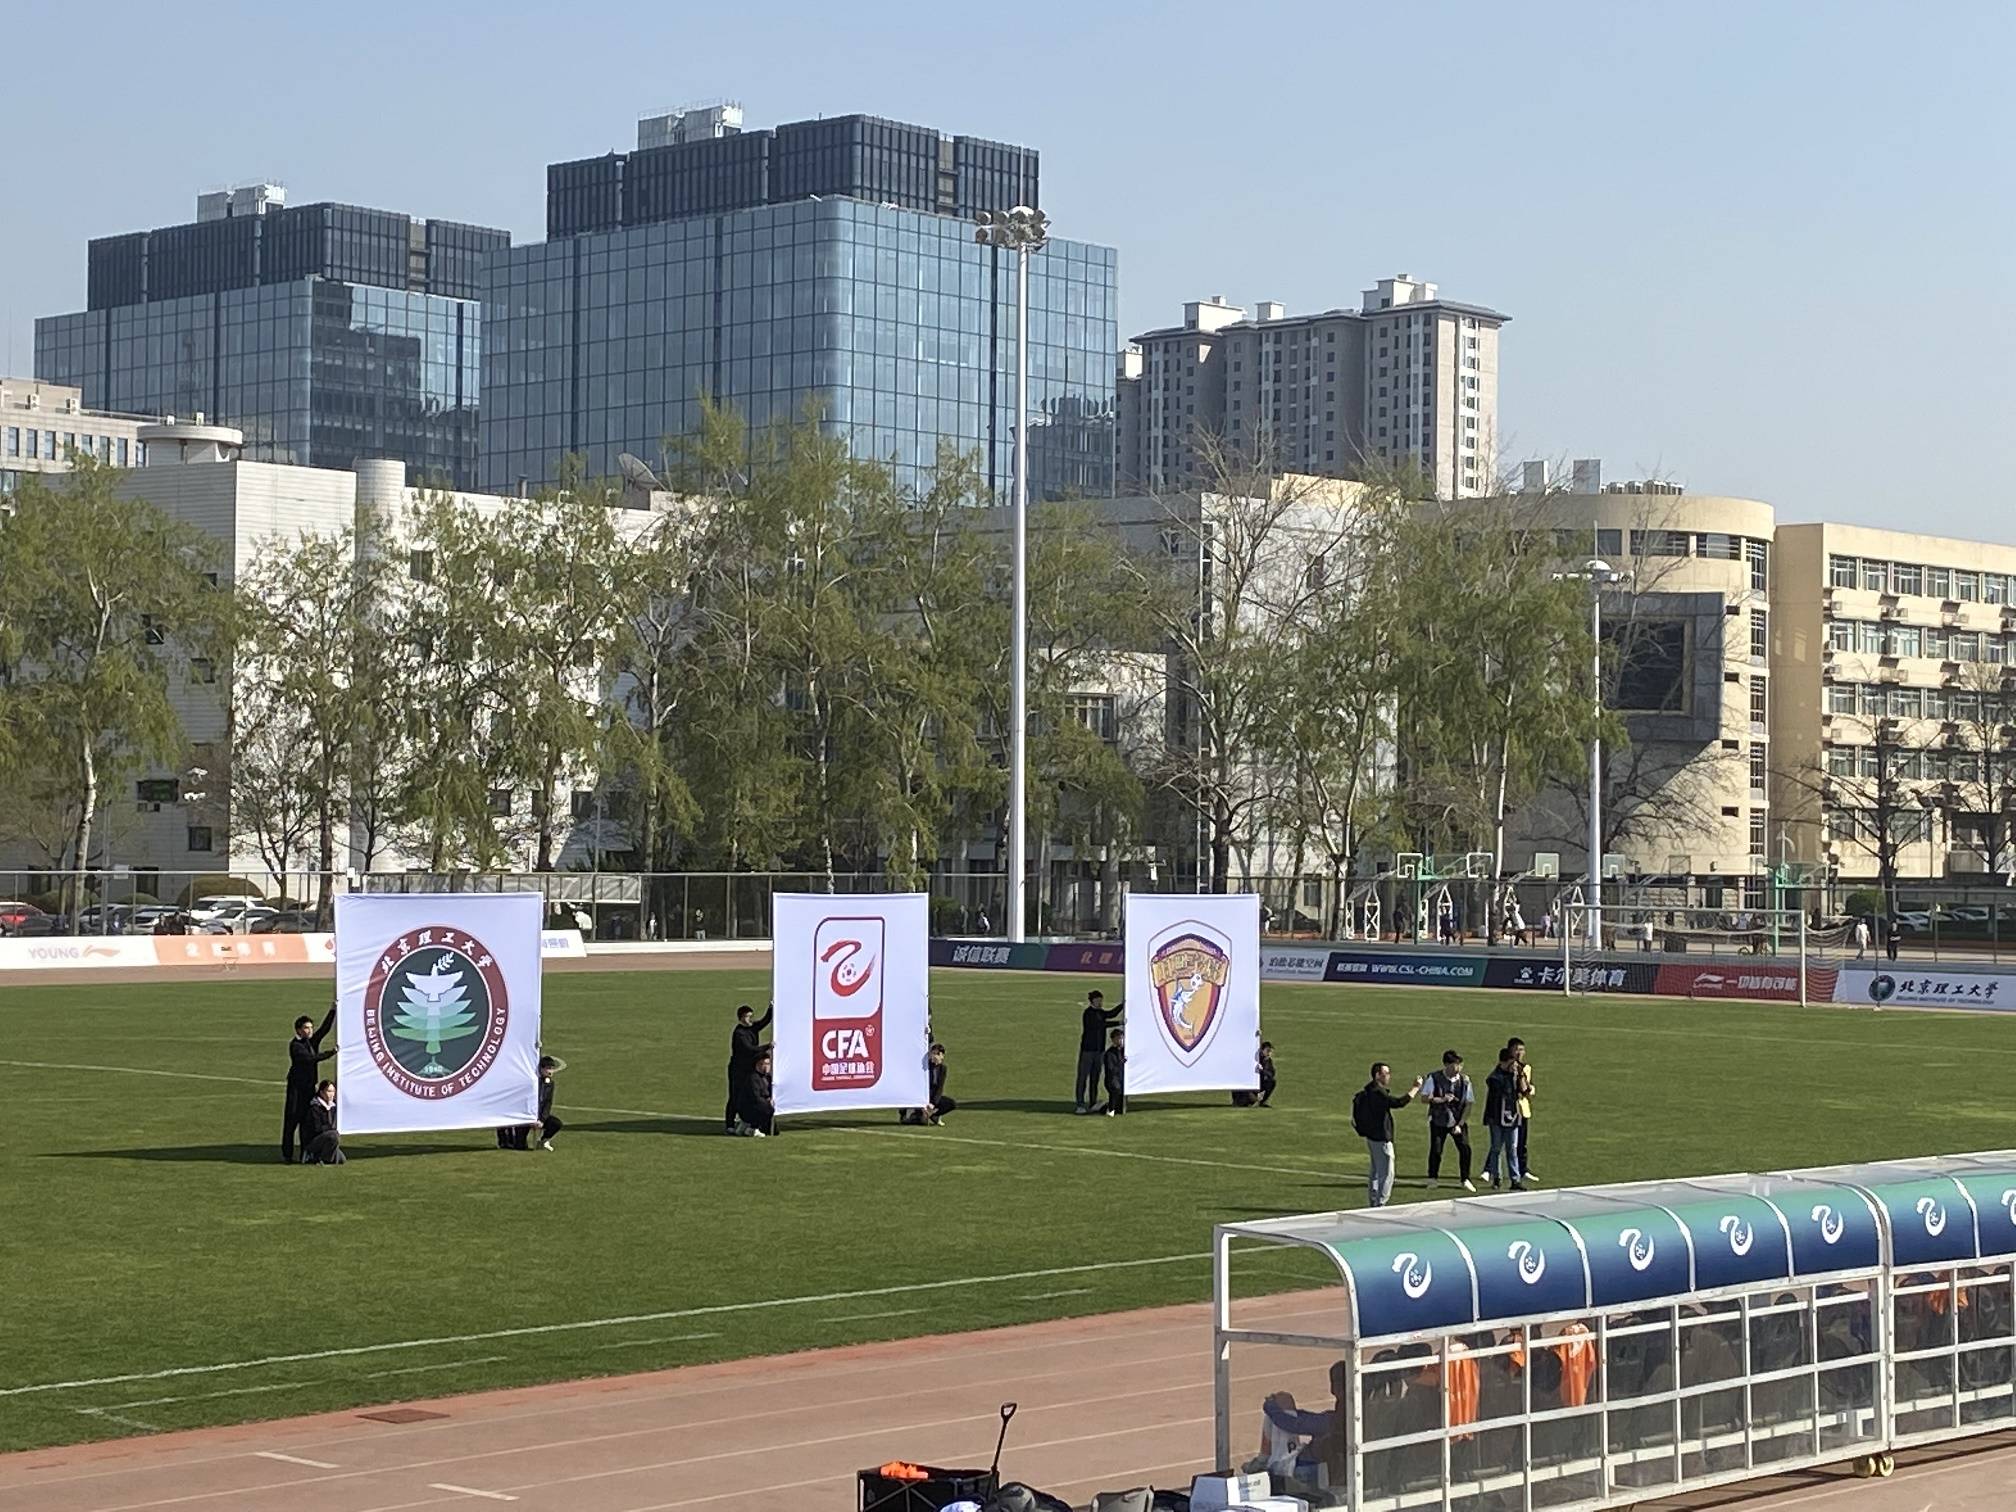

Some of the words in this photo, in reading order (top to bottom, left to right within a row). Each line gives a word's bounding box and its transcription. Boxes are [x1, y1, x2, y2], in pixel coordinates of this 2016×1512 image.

[28, 948, 80, 960] YOUNG
[381, 930, 493, 974] 北京理工大学
[952, 945, 1011, 964] 诚信联赛
[1898, 978, 1999, 999] 北京理工大学
[366, 1009, 385, 1063] BEIJING
[383, 1062, 435, 1097] INSTITUTE
[440, 1082, 455, 1097] OF
[460, 1007, 506, 1087] TECHNOLOGY
[821, 1029, 869, 1059] CFA
